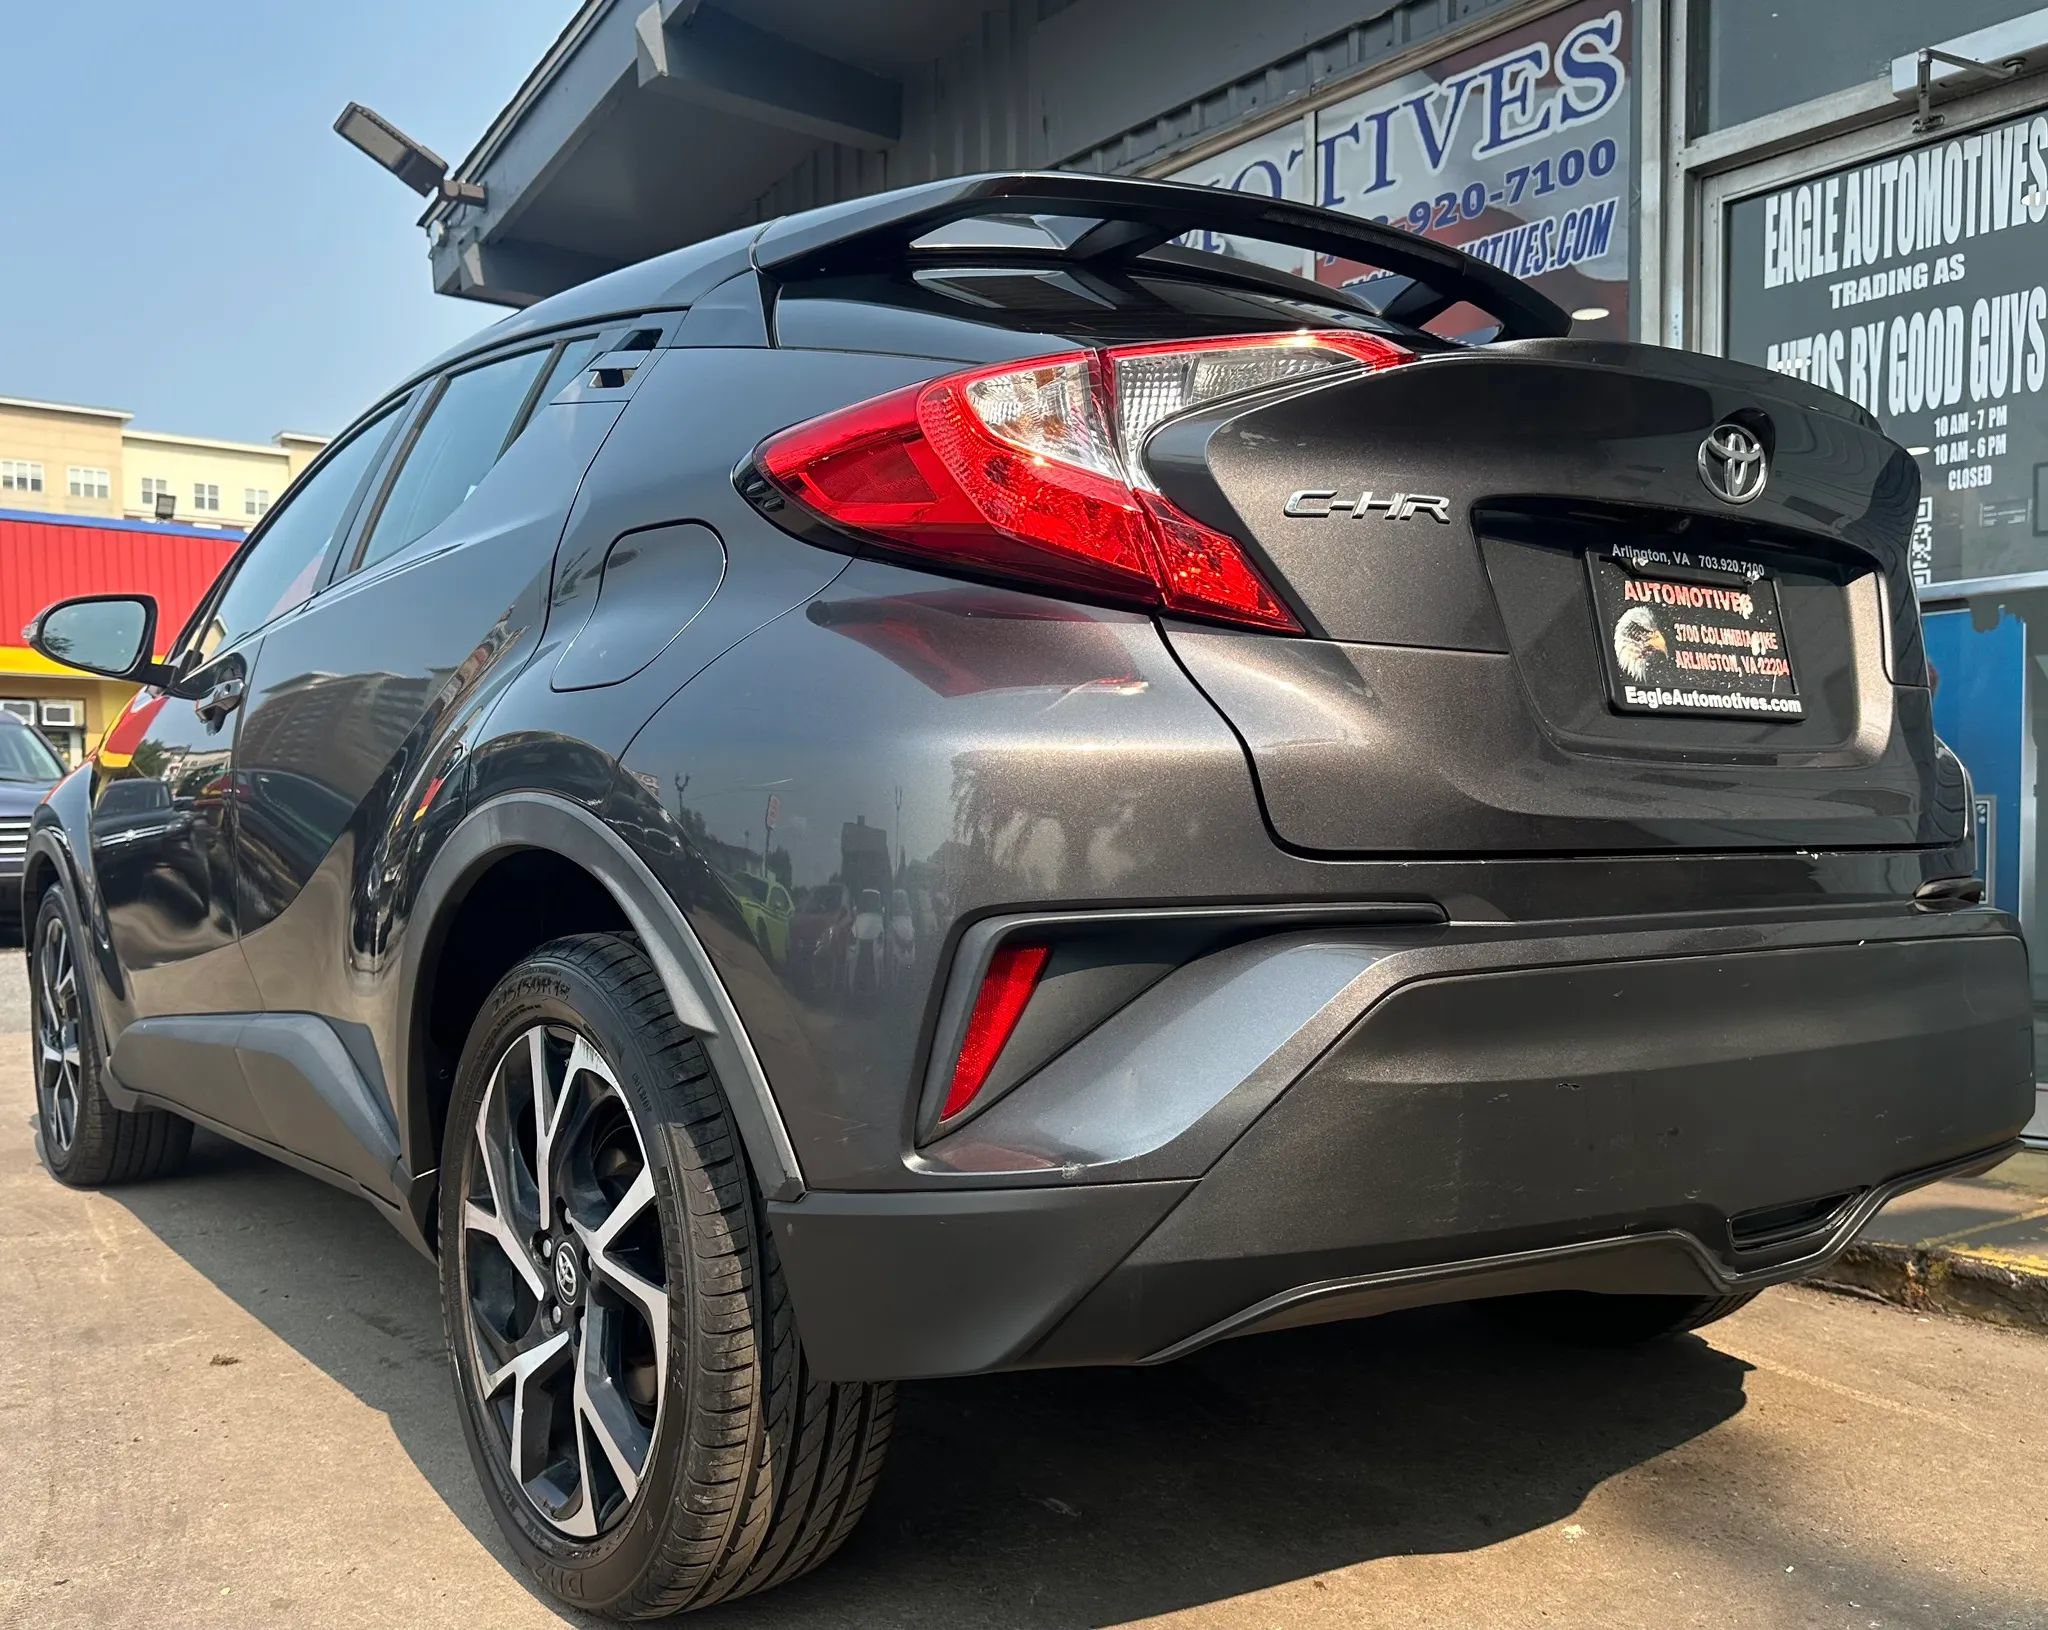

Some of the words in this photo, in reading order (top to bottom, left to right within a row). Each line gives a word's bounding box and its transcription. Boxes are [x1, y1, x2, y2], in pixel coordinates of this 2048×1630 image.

[1764, 176, 1839, 289] EAGLE
[1842, 116, 2048, 270] AUTOMOTIVES
[1829, 262, 1928, 309] TRADING
[1933, 253, 1965, 285] AS
[1766, 329, 1845, 396] AUTOS
[1849, 321, 1885, 418] BY
[1888, 305, 1965, 417] GOOD
[1969, 286, 2047, 402] GUYS
[1934, 416, 1949, 438] 10
[1949, 412, 1969, 435] AM
[1977, 409, 1985, 430] 7
[1988, 405, 2008, 428] PM
[1933, 443, 1949, 466] 10
[1949, 440, 1969, 463] AM
[1976, 437, 1986, 459] 6
[1987, 433, 2007, 457] PM
[1948, 464, 1992, 491] CLOSED
[1284, 490, 1451, 524] C-HR
[1612, 543, 1671, 566] Arlington,
[1673, 551, 1690, 566] VA
[1698, 555, 1765, 577] 703.920.7100
[1674, 623, 1700, 643] 3700
[1700, 624, 1752, 648] COLUMBIA
[1675, 650, 1742, 677] ARLINGTON,
[1741, 655, 1758, 674] VA
[1624, 686, 1802, 713] EagleAutomotives.com
